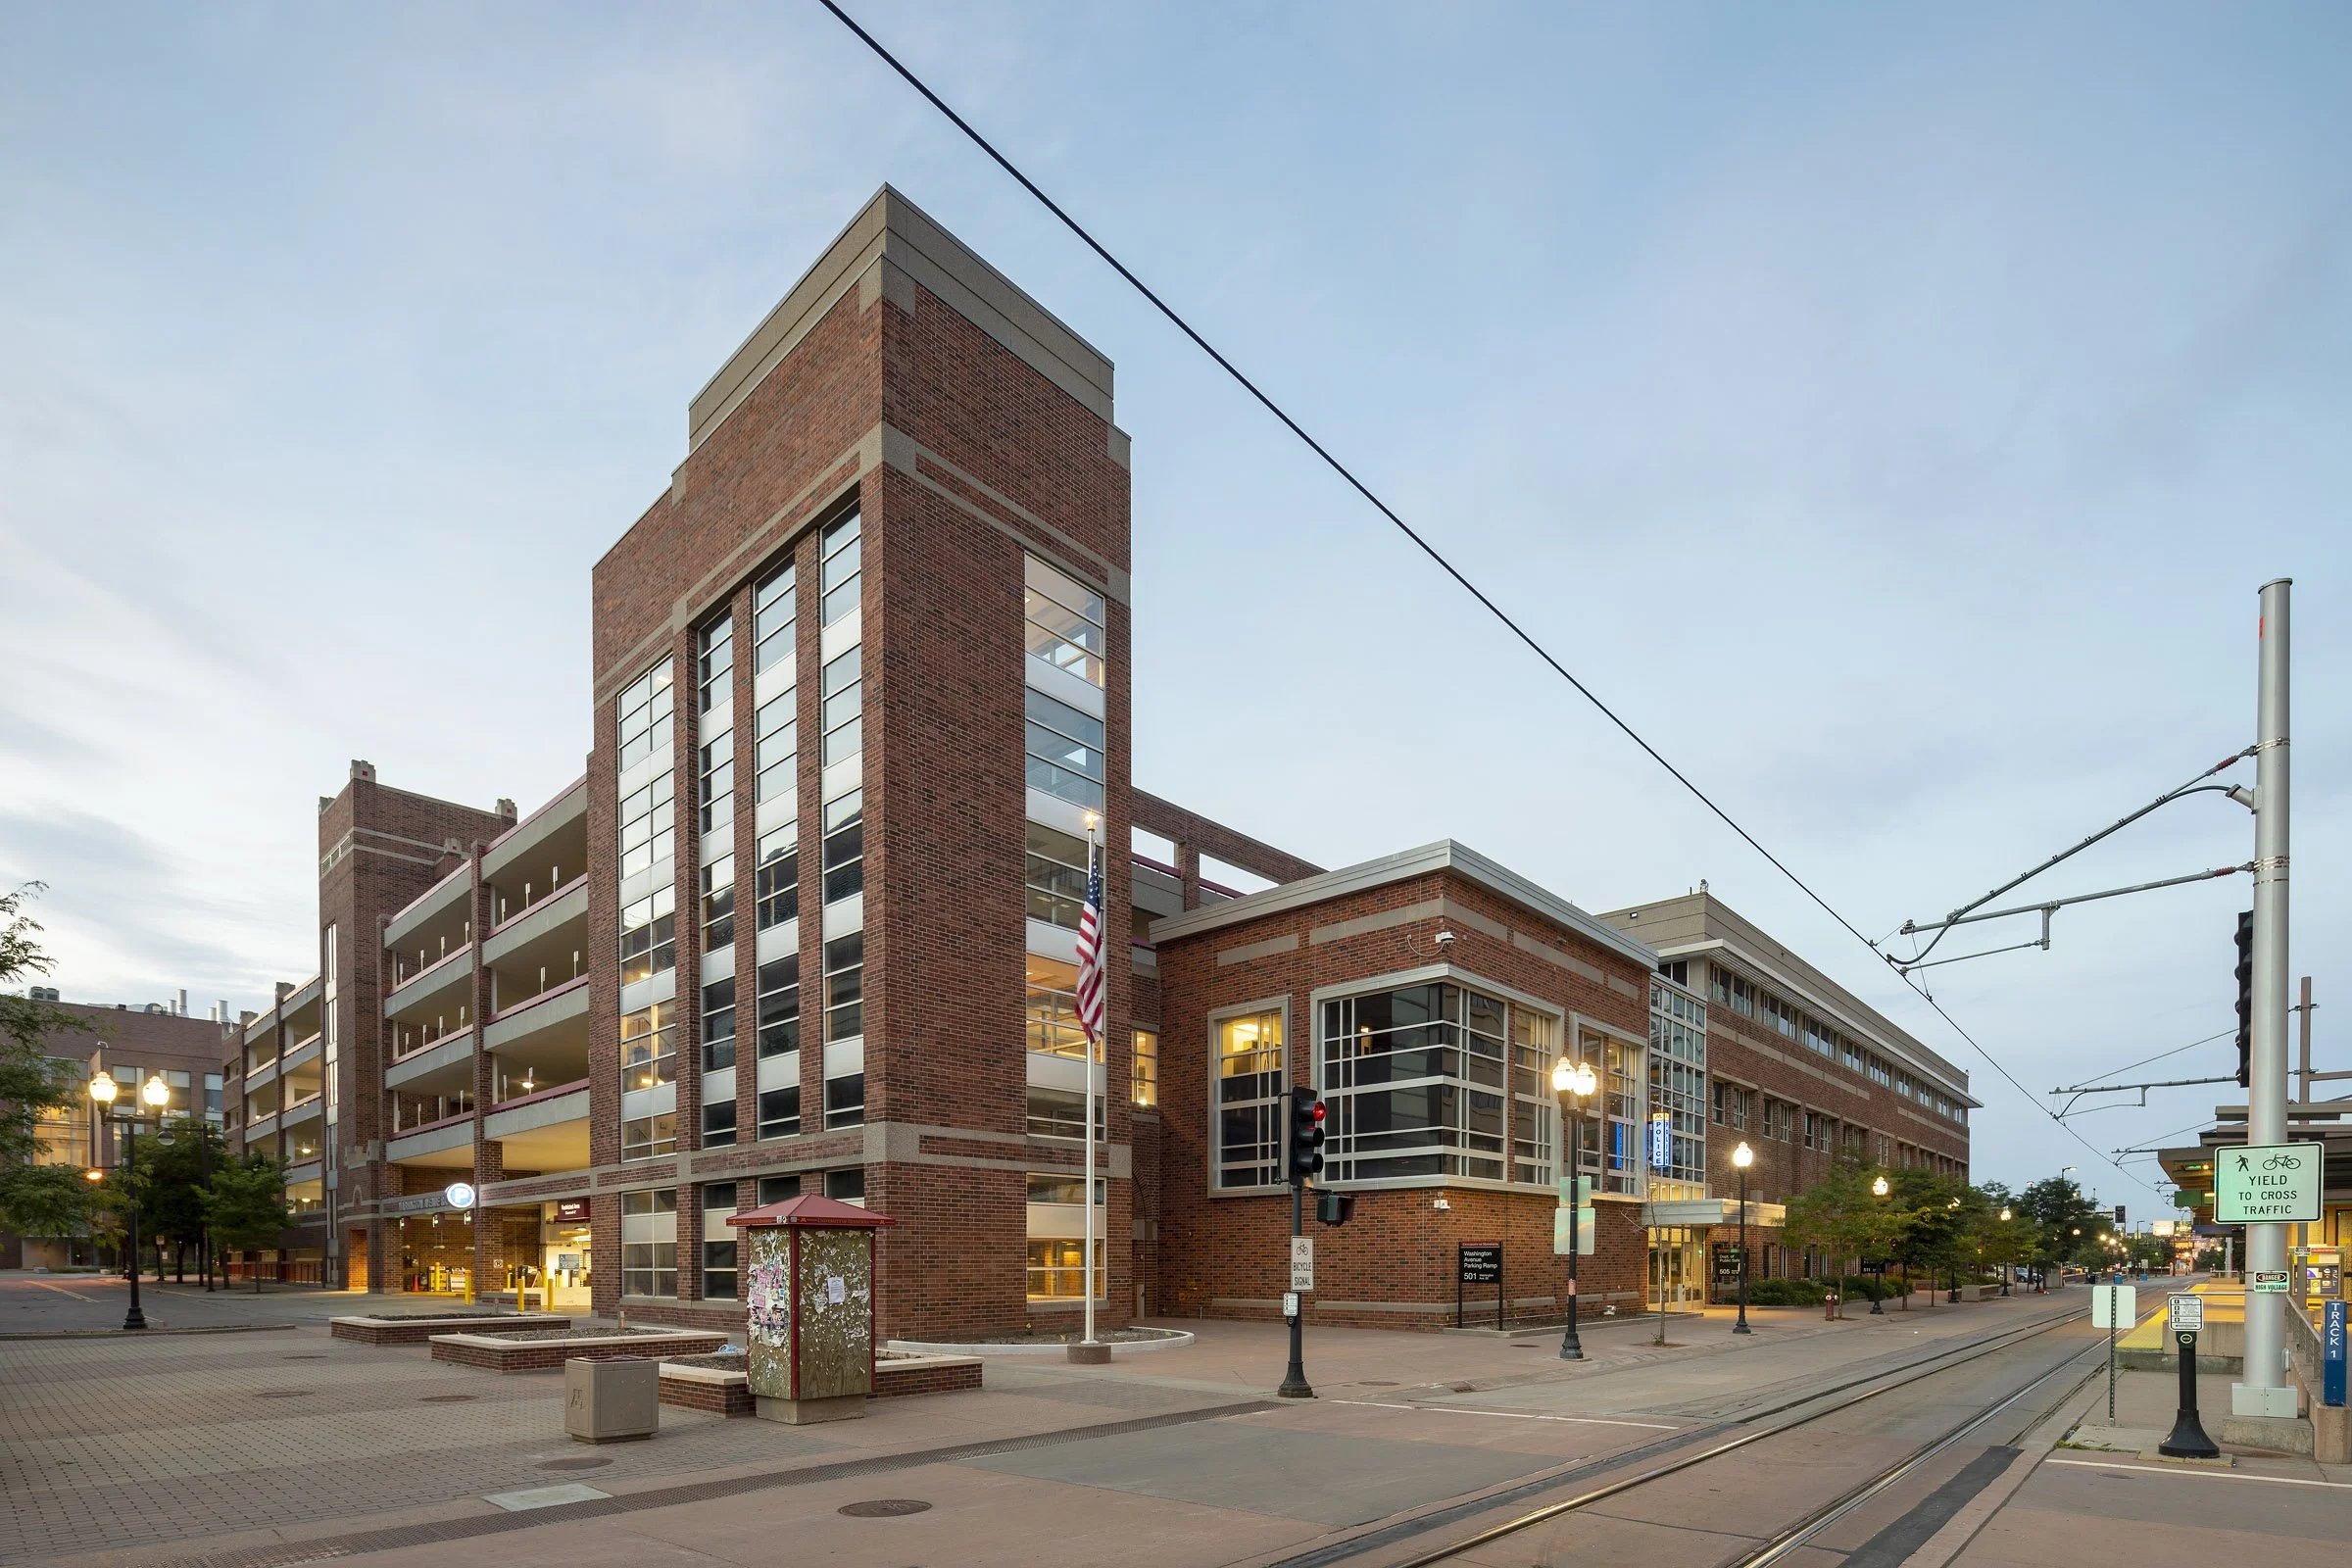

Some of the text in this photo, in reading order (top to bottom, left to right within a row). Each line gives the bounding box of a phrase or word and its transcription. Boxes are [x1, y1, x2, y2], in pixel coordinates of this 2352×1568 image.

[2249, 1175, 2287, 1186] YIELD
[2238, 1190, 2297, 1200] TO CROSS
[2243, 1205, 2292, 1215] TRAFFIC
[1293, 1262, 1312, 1272] BICYCLE
[1294, 1276, 1311, 1286] SIGNAL
[2330, 1303, 2340, 1358] TRACK 1
